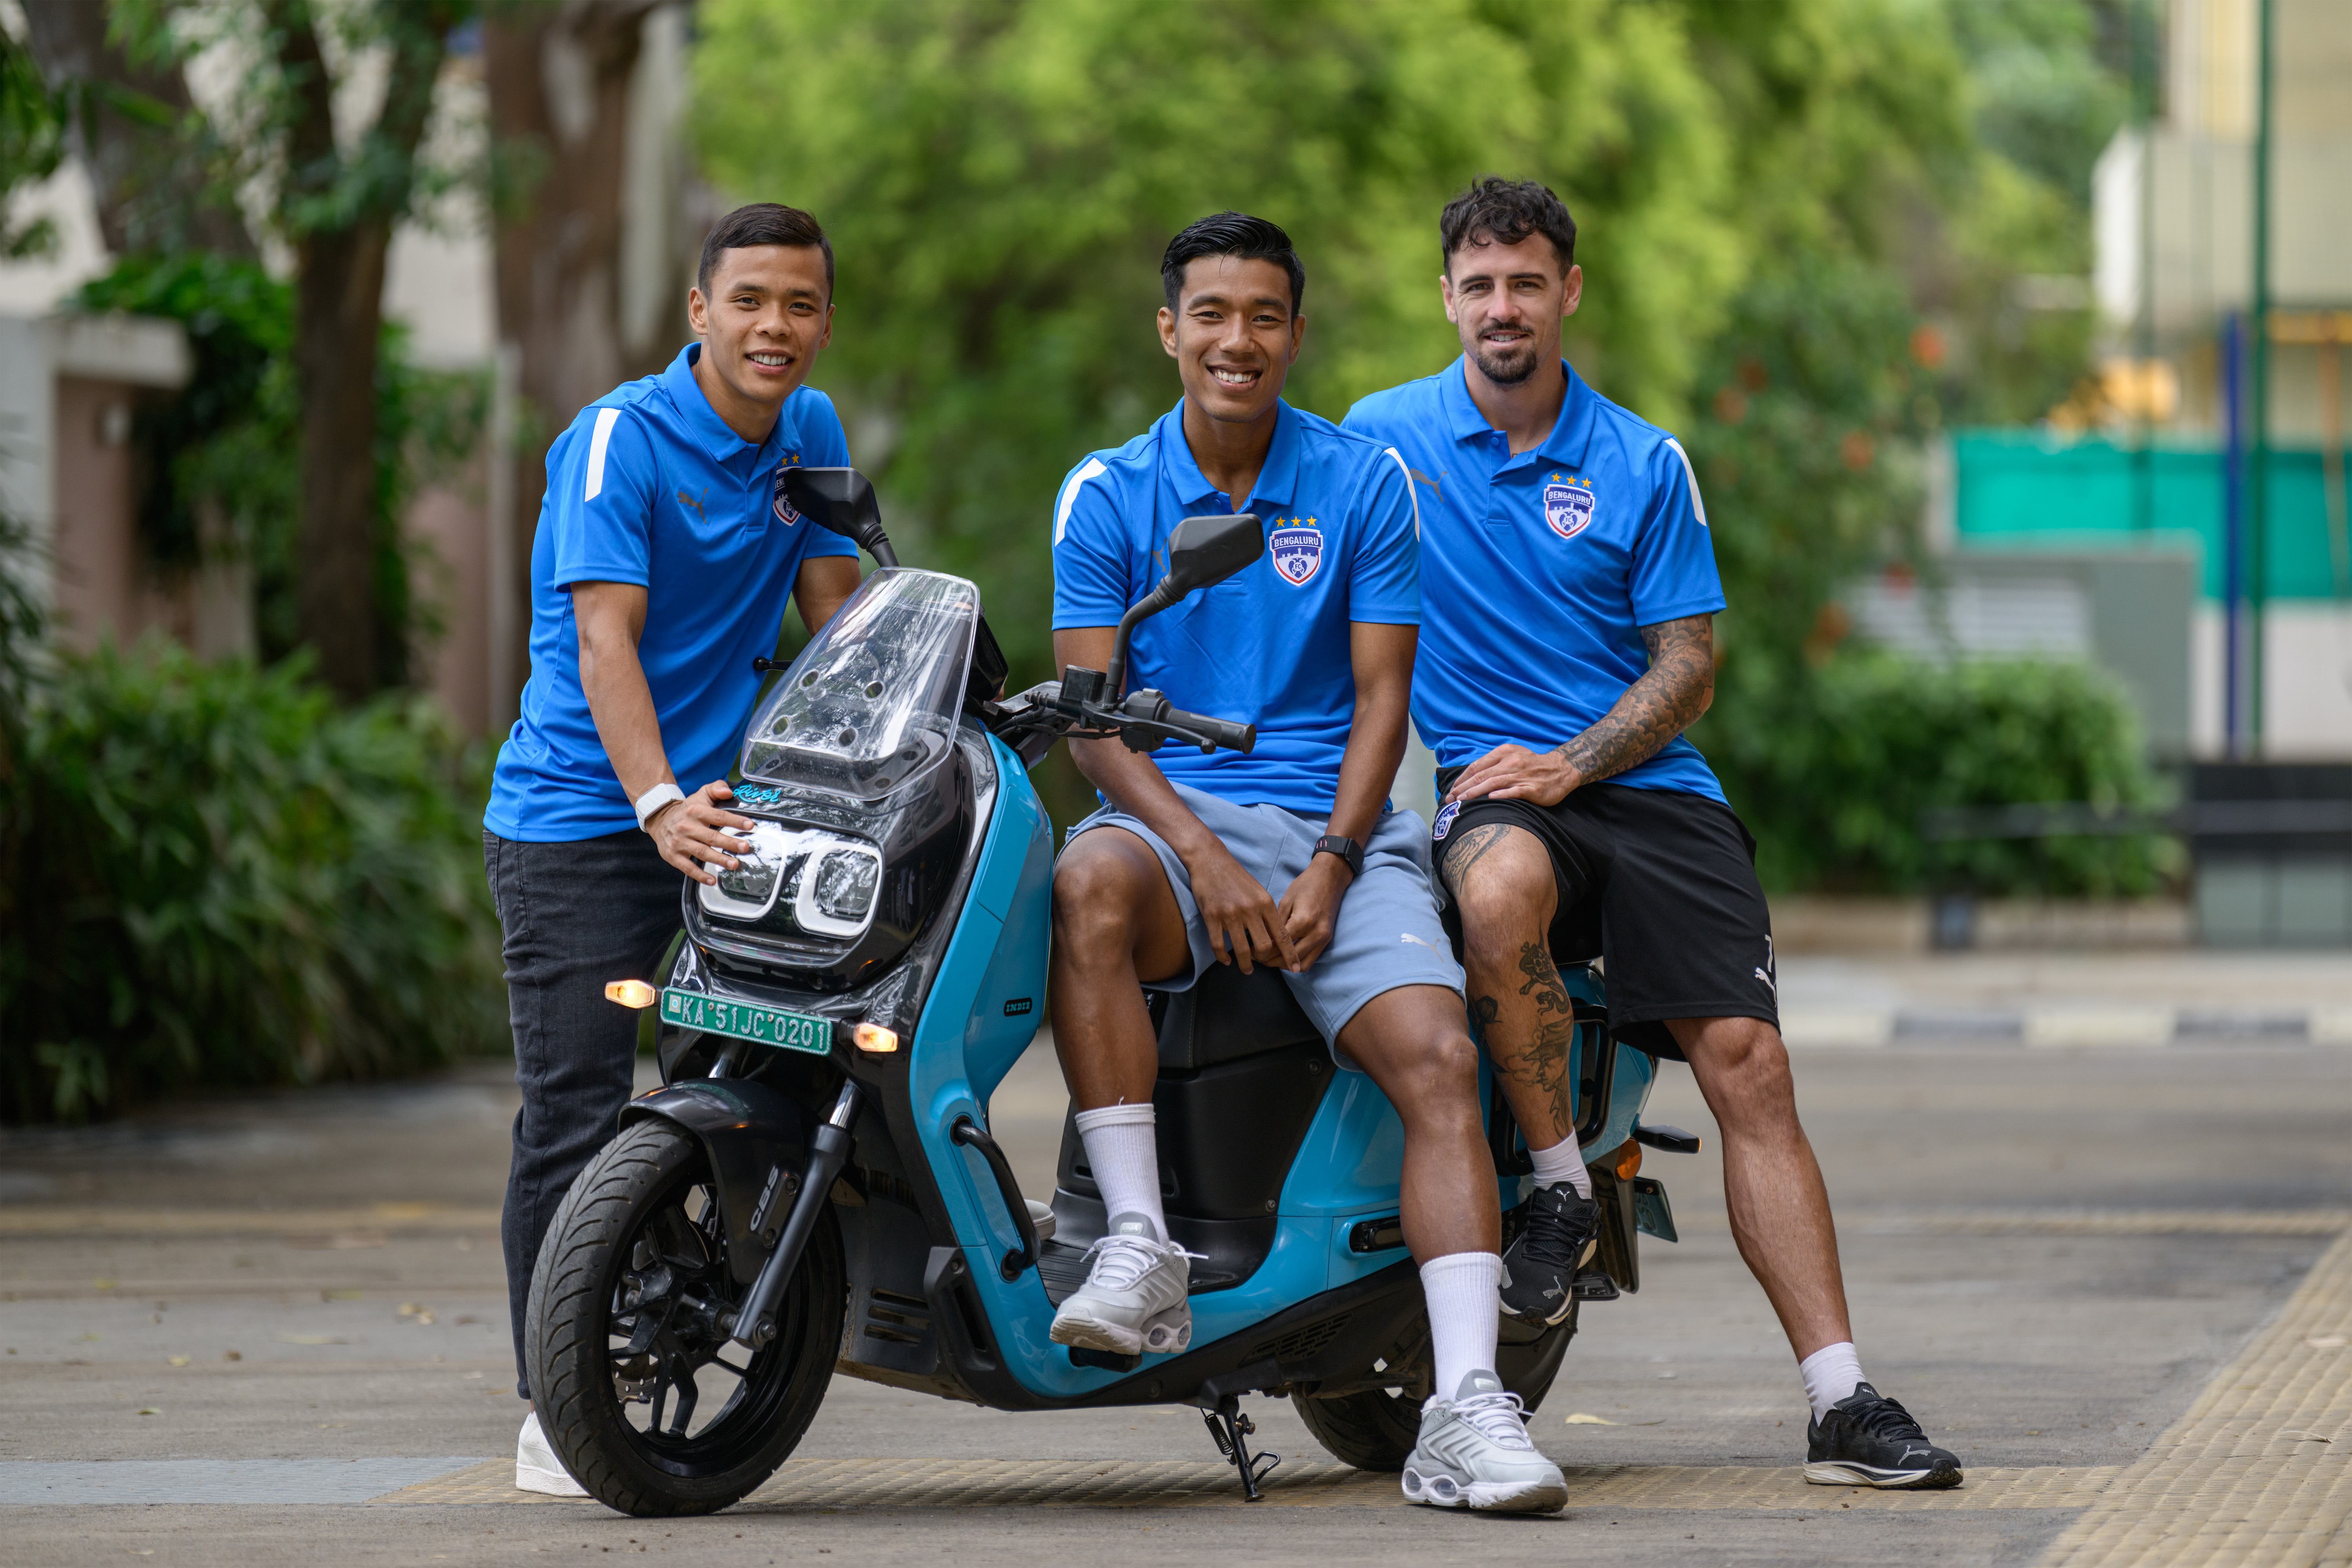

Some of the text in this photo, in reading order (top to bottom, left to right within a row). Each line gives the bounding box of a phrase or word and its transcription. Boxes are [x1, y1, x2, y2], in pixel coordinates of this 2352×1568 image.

[1548, 491, 1591, 505] BENGALURU
[1274, 536, 1319, 548] BENGALURU
[733, 784, 782, 803] River
[1006, 1002, 1031, 1013] INDIE
[682, 997, 704, 1026] KA
[774, 1016, 824, 1049] 0201
[750, 1165, 779, 1231] CBS
